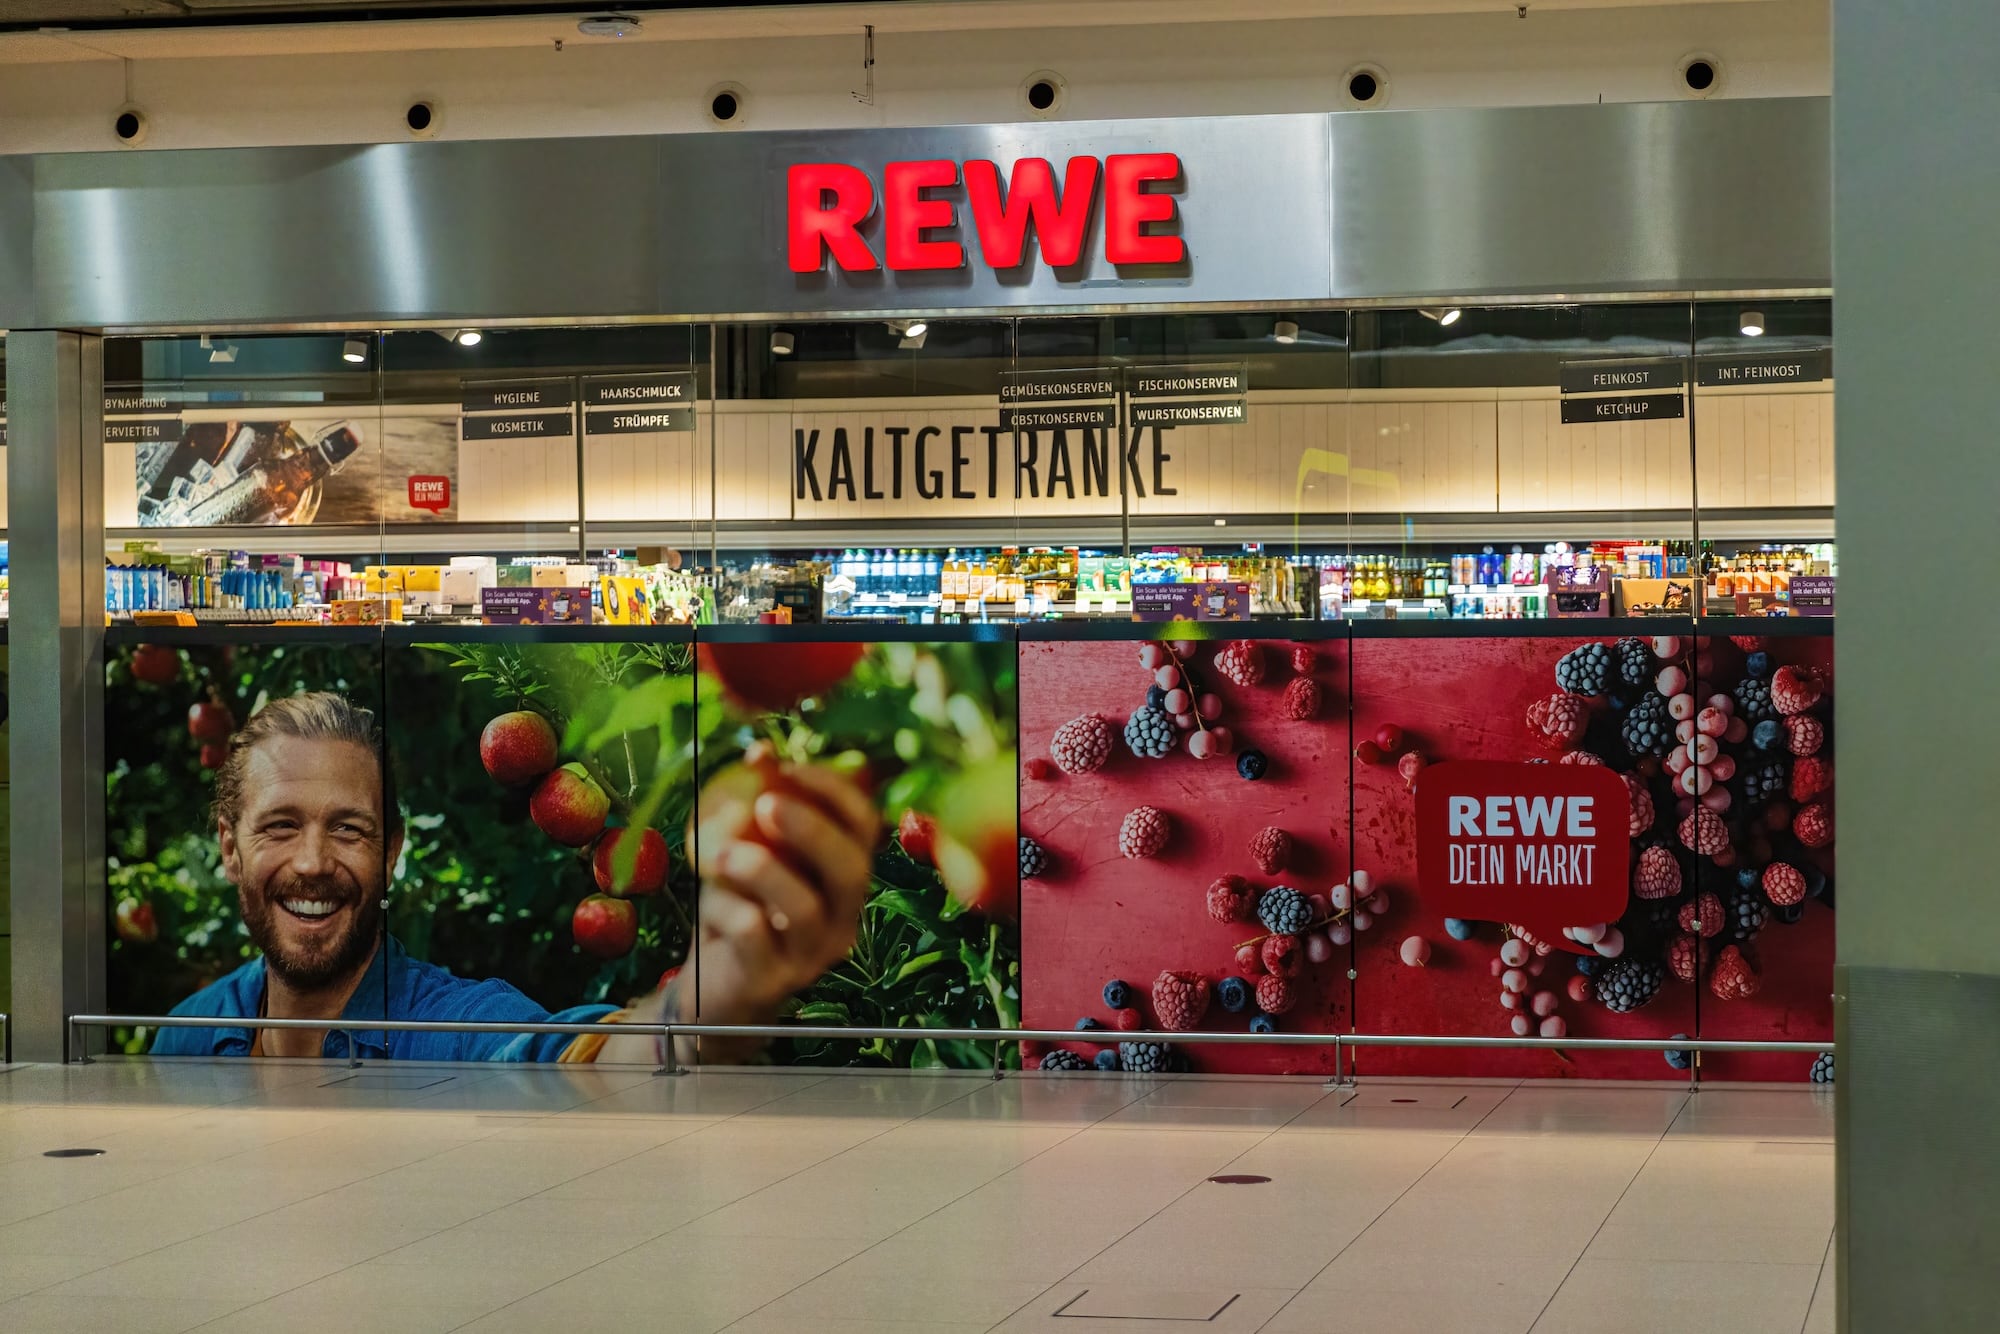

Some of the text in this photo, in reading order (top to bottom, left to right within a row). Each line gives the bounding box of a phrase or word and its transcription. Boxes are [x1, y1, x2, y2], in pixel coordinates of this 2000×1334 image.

[787, 152, 1188, 273] REWE
[1593, 371, 1649, 386] FEINKOST
[1718, 364, 1801, 380] INT. FEINKOST
[1001, 381, 1113, 397] GEMÜSEKONSERVEN
[1138, 376, 1238, 391] FISCHKONSERVEN
[494, 391, 540, 405] HYGIENE
[600, 385, 682, 400] HAARSCHMUCK
[1136, 406, 1243, 421] WURSTKONSERVEN
[1596, 402, 1649, 416] KETCHUP
[613, 413, 670, 429] STRÜMPFE
[1011, 412, 1105, 425] OBSTKONSERVEN
[105, 426, 160, 438] ERVIETTEN
[491, 420, 544, 434] KOSMETIK
[414, 481, 444, 491] REWE
[1449, 796, 1596, 837] REWE
[1449, 844, 1596, 886] DEIN MARKT
